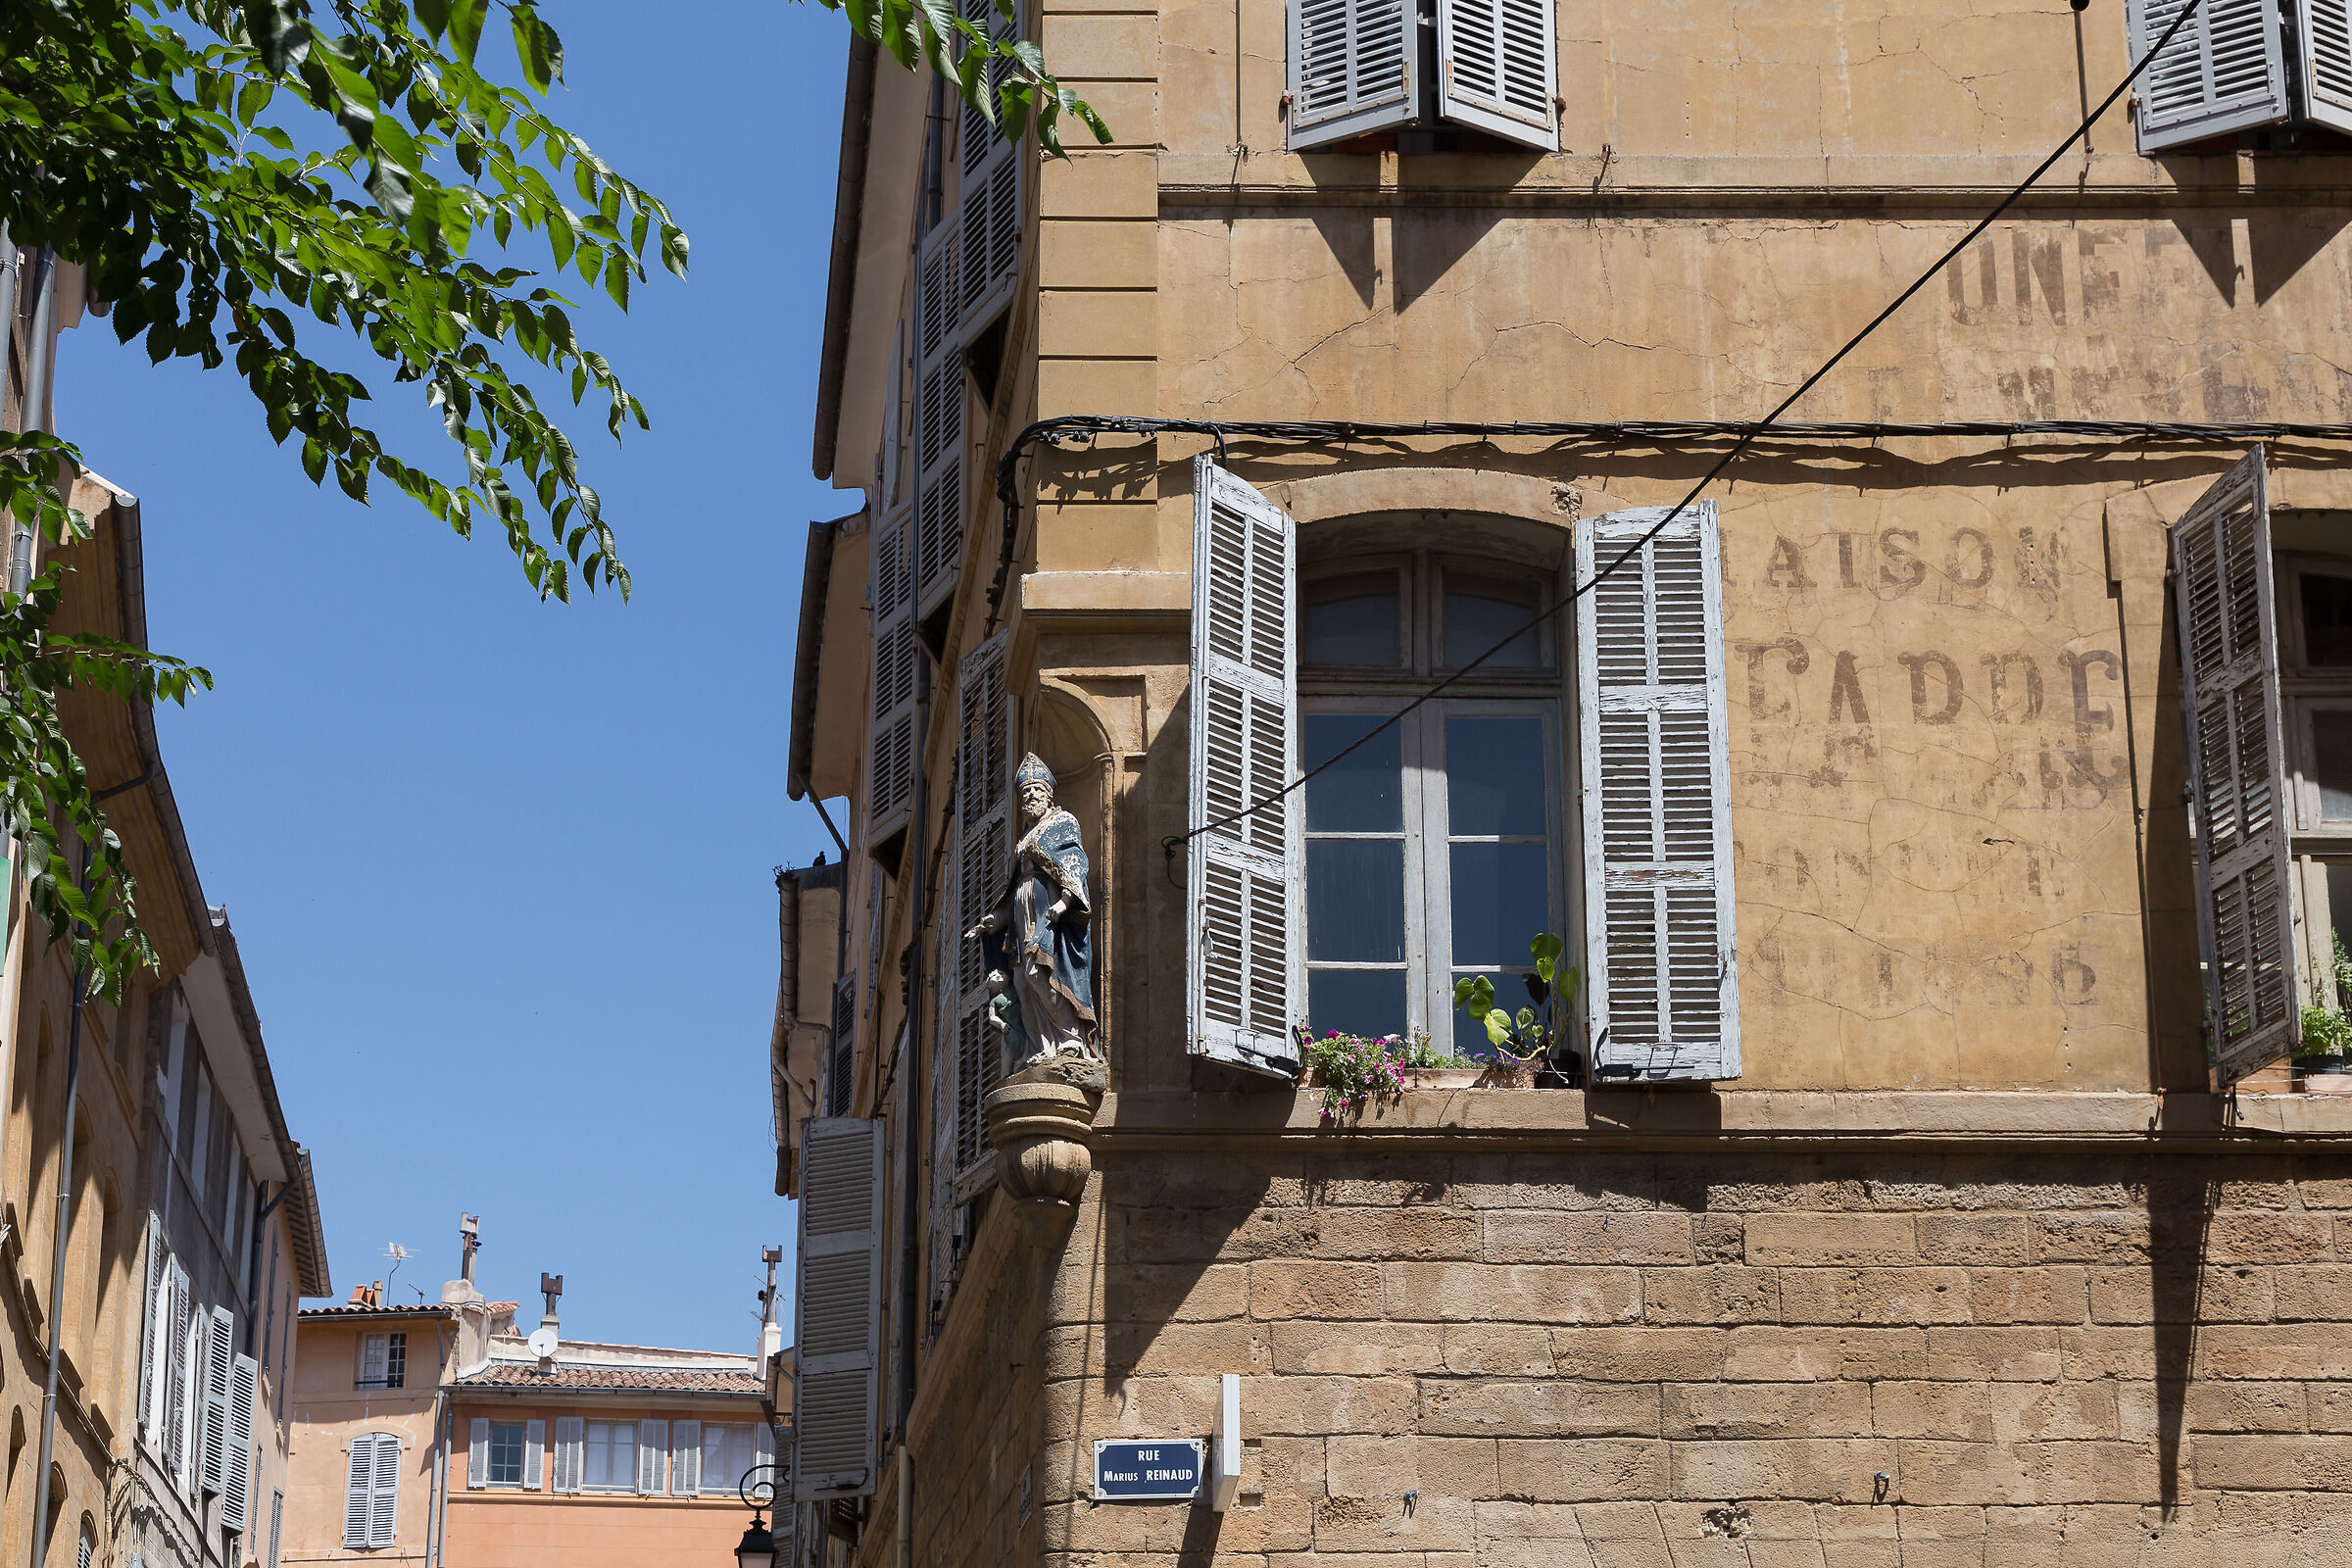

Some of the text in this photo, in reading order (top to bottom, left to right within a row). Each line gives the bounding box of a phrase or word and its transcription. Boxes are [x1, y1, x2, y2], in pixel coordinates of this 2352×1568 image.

[1138, 1449, 1160, 1461] RUE
[1103, 1469, 1194, 1482] MARIUS REINAUD
